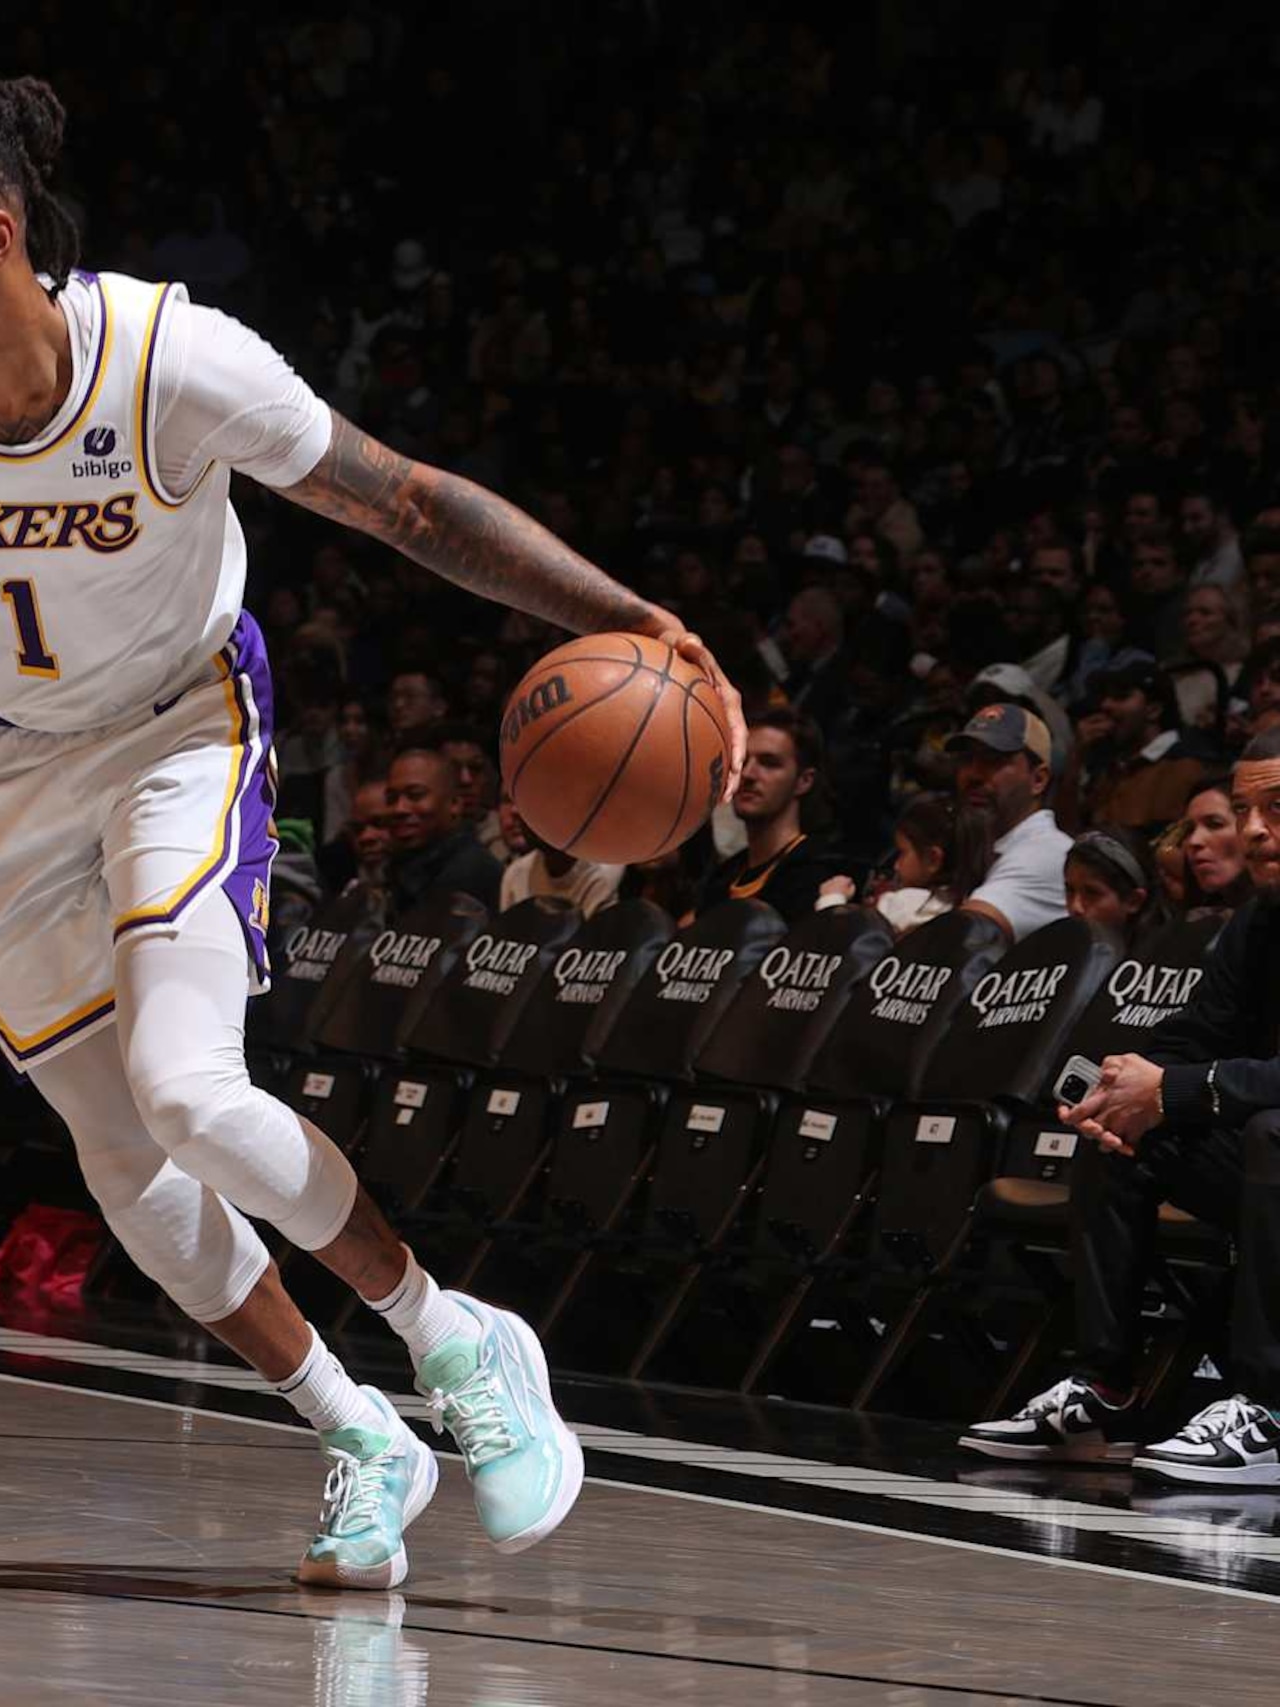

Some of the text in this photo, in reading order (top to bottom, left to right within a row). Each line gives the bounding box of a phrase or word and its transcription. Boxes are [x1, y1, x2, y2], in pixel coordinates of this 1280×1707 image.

[72, 459, 132, 479] bibigo
[0, 576, 61, 681] 1
[369, 930, 441, 968] QATAR
[465, 933, 539, 975] QATAR
[553, 947, 627, 986] QATAR
[656, 941, 735, 984] QATAR
[760, 946, 842, 990] QATAR
[869, 956, 953, 1001] QATAR
[970, 963, 1069, 1015] QATAR
[1107, 959, 1204, 1008] QATAR
